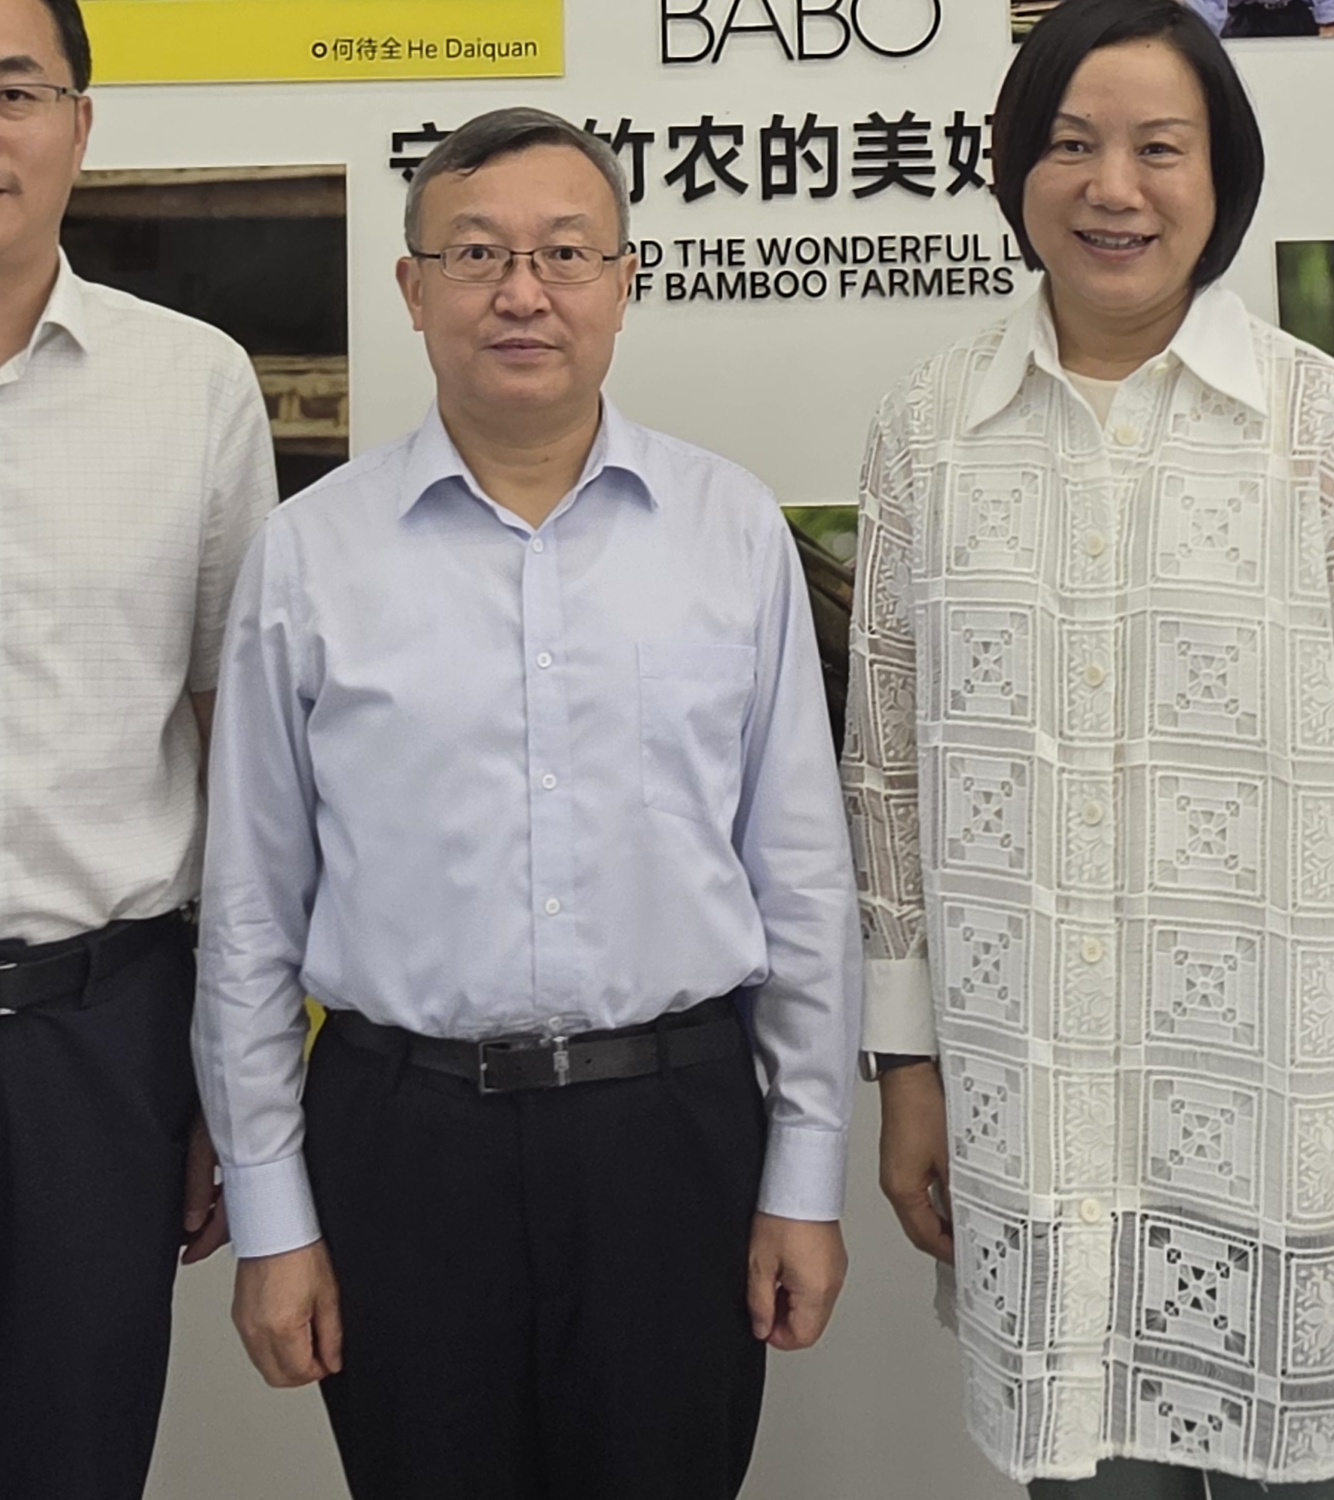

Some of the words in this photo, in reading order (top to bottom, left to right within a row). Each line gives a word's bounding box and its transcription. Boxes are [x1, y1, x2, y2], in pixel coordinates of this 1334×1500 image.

[332, 36, 402, 61] 何待全
[407, 39, 438, 59] He
[446, 37, 538, 63] Daiquan
[673, 238, 746, 268] THE
[756, 233, 992, 267] WONDERFUL
[665, 269, 828, 301] BAMBOO
[840, 266, 1015, 299] FARMERS
